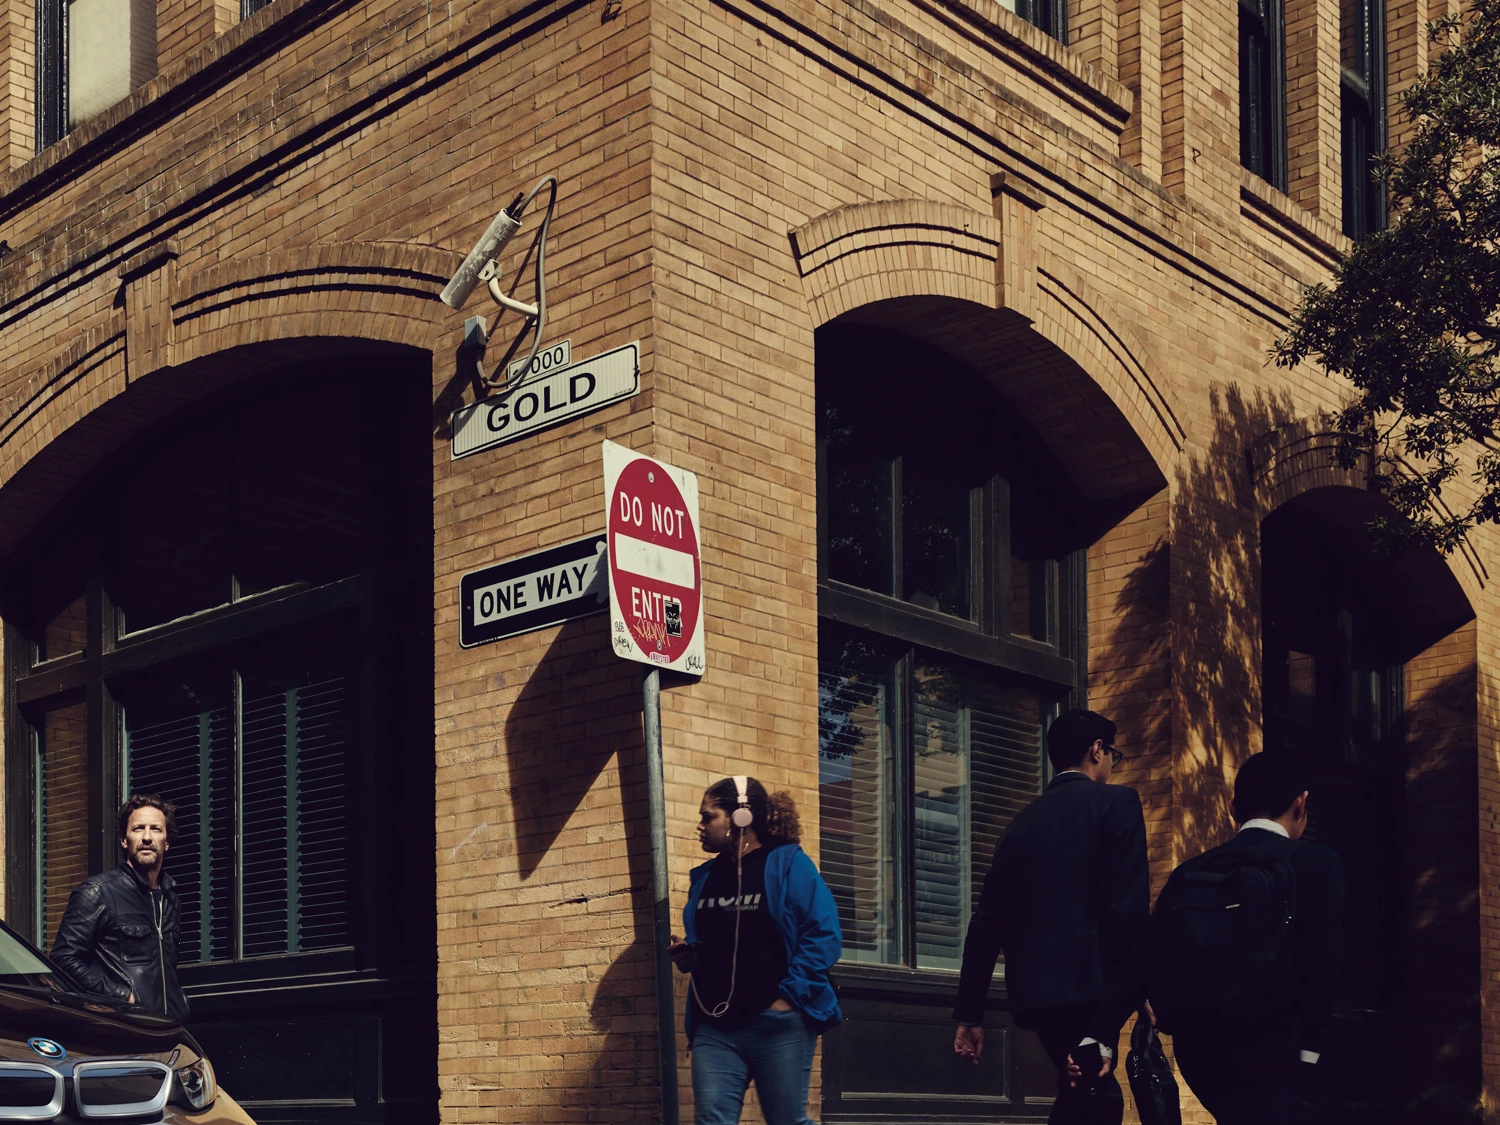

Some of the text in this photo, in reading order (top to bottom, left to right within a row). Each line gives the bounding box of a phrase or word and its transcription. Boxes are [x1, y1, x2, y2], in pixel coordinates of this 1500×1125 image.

[531, 346, 564, 374] 000
[486, 372, 596, 433] GOLD
[619, 491, 684, 539] DO NOT
[480, 563, 589, 618] ONE WAY
